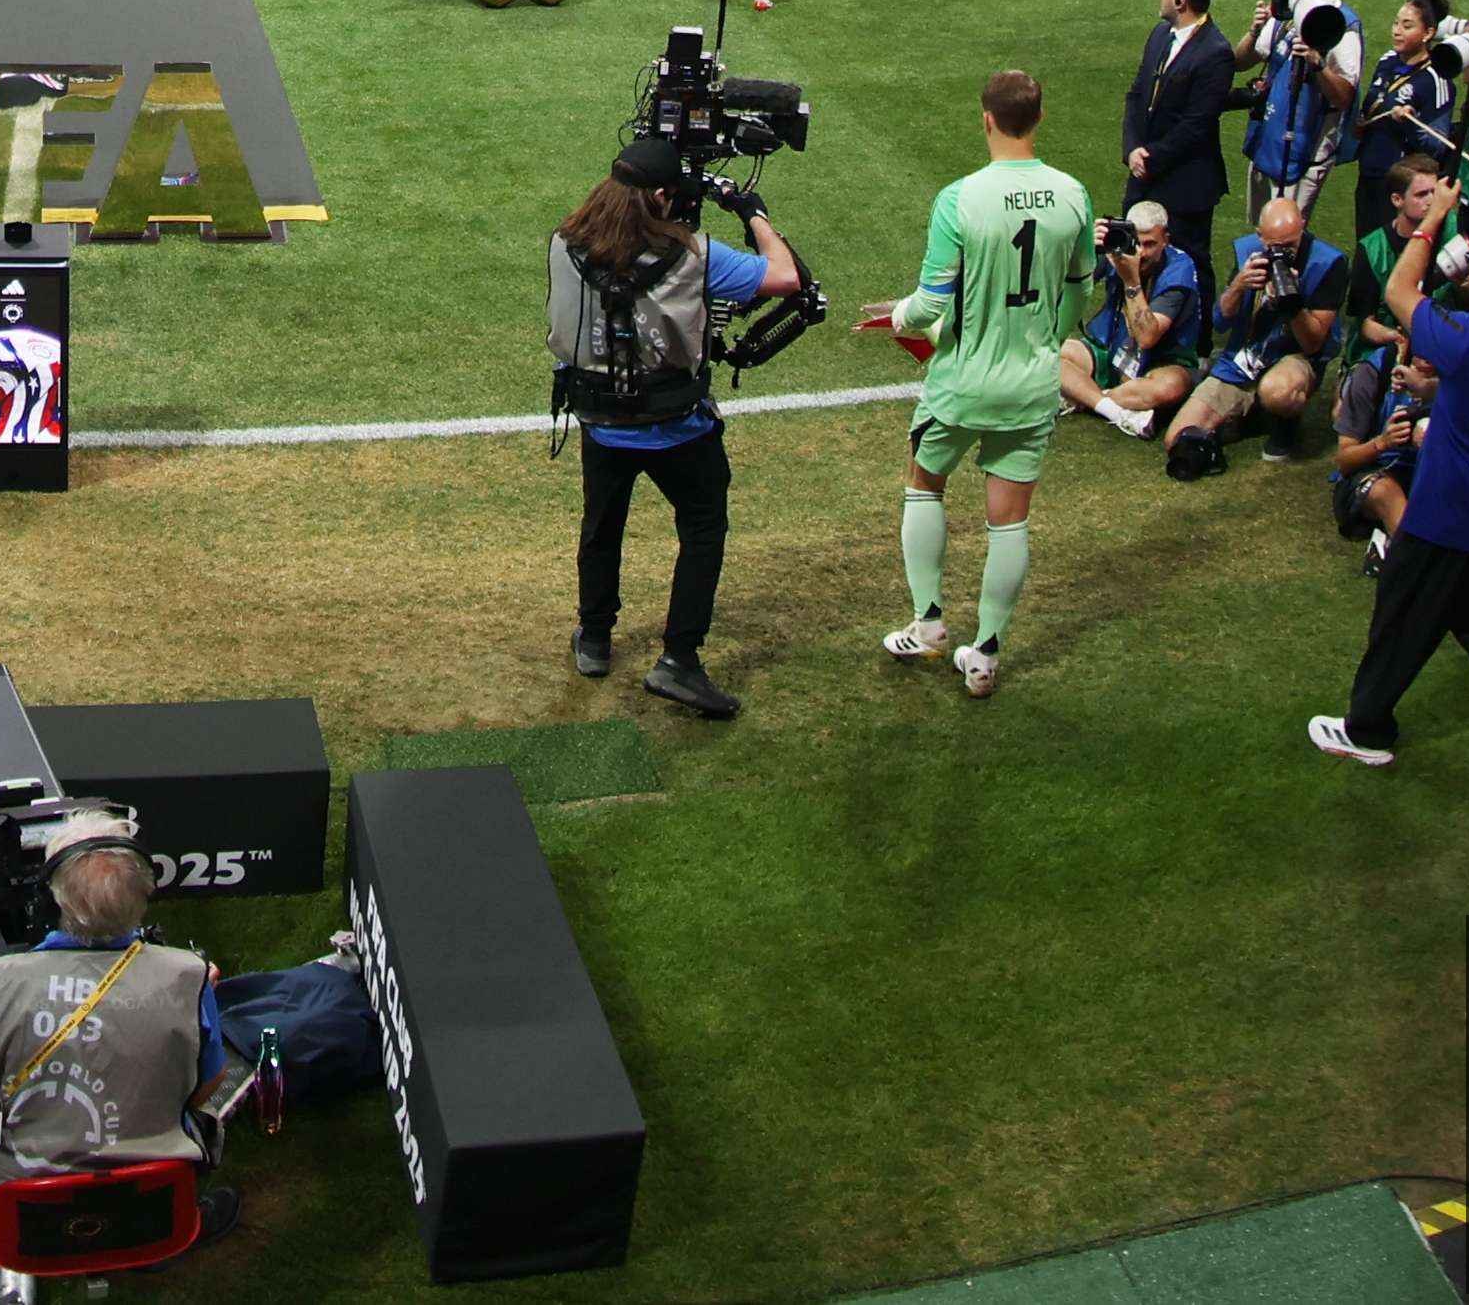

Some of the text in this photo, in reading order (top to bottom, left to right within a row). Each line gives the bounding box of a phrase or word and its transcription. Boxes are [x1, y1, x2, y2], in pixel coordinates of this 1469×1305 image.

[1004, 191, 1055, 212] NEUER
[1005, 219, 1039, 308] 1
[47, 974, 100, 1006] HB
[368, 883, 413, 1079] FIFA CLUB
[103, 1100, 120, 1146] CUP
